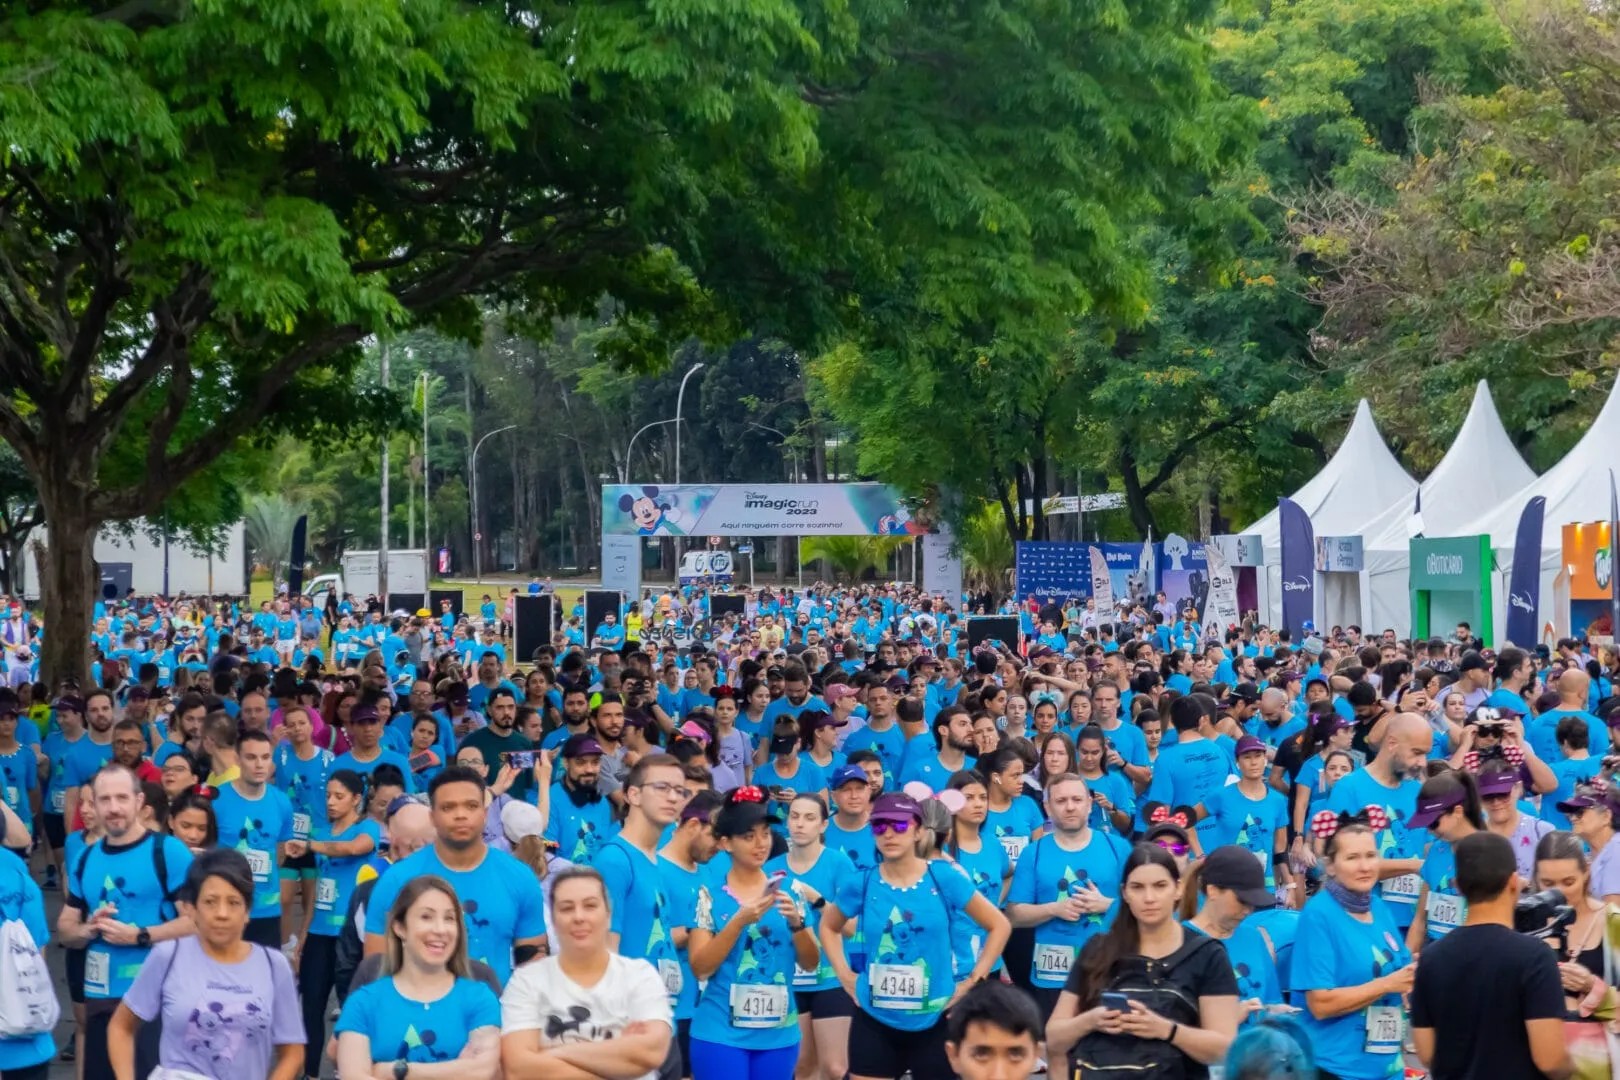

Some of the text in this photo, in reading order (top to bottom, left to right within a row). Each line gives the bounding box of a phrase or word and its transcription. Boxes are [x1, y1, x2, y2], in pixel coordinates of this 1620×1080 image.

[744, 491, 768, 500] Disney
[1048, 586, 1072, 599] Disney
[1042, 954, 1068, 970] 7044
[880, 976, 915, 996] 4348
[743, 998, 774, 1016] 4314
